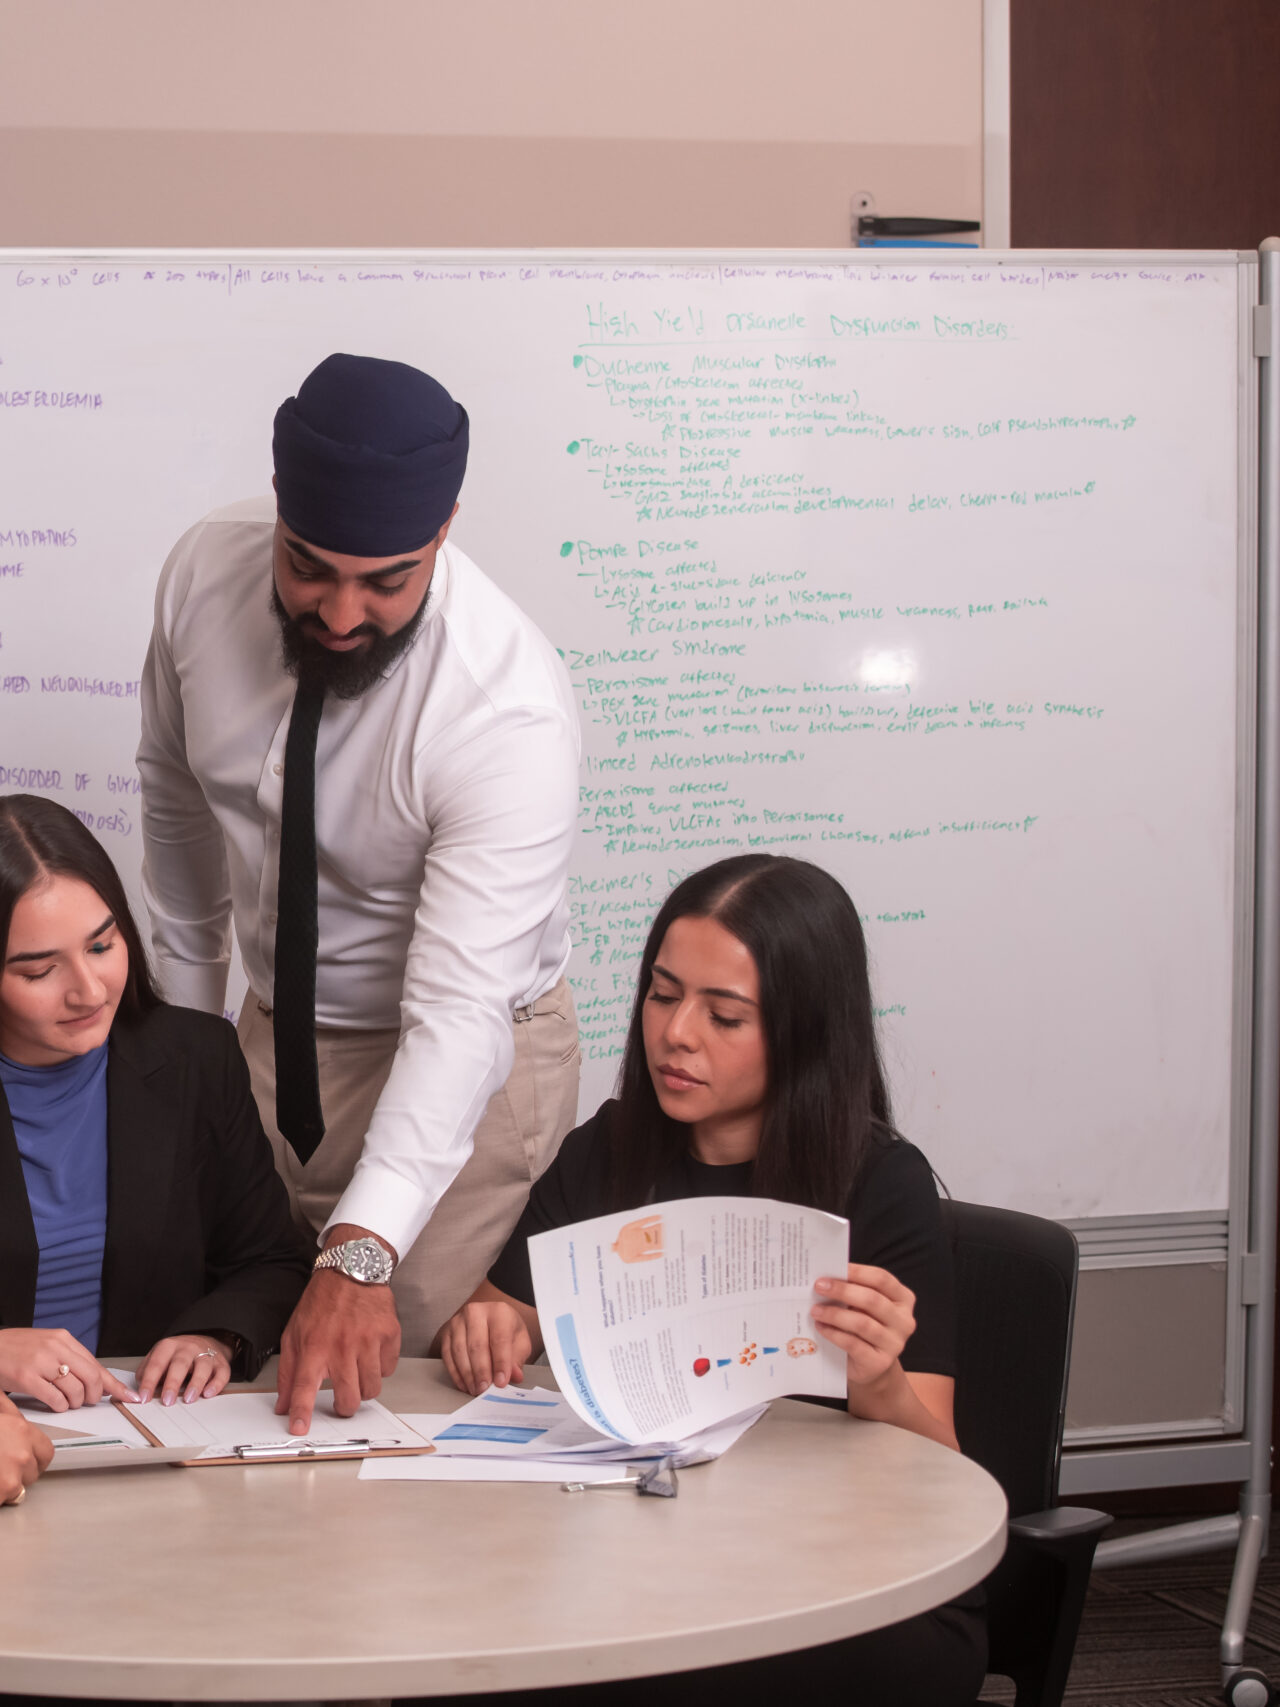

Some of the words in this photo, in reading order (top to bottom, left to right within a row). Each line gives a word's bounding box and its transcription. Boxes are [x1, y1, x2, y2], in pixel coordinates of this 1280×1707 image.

[586, 301, 640, 344] High
[75, 772, 92, 792] OF
[569, 1357, 596, 1409] diabetes?
